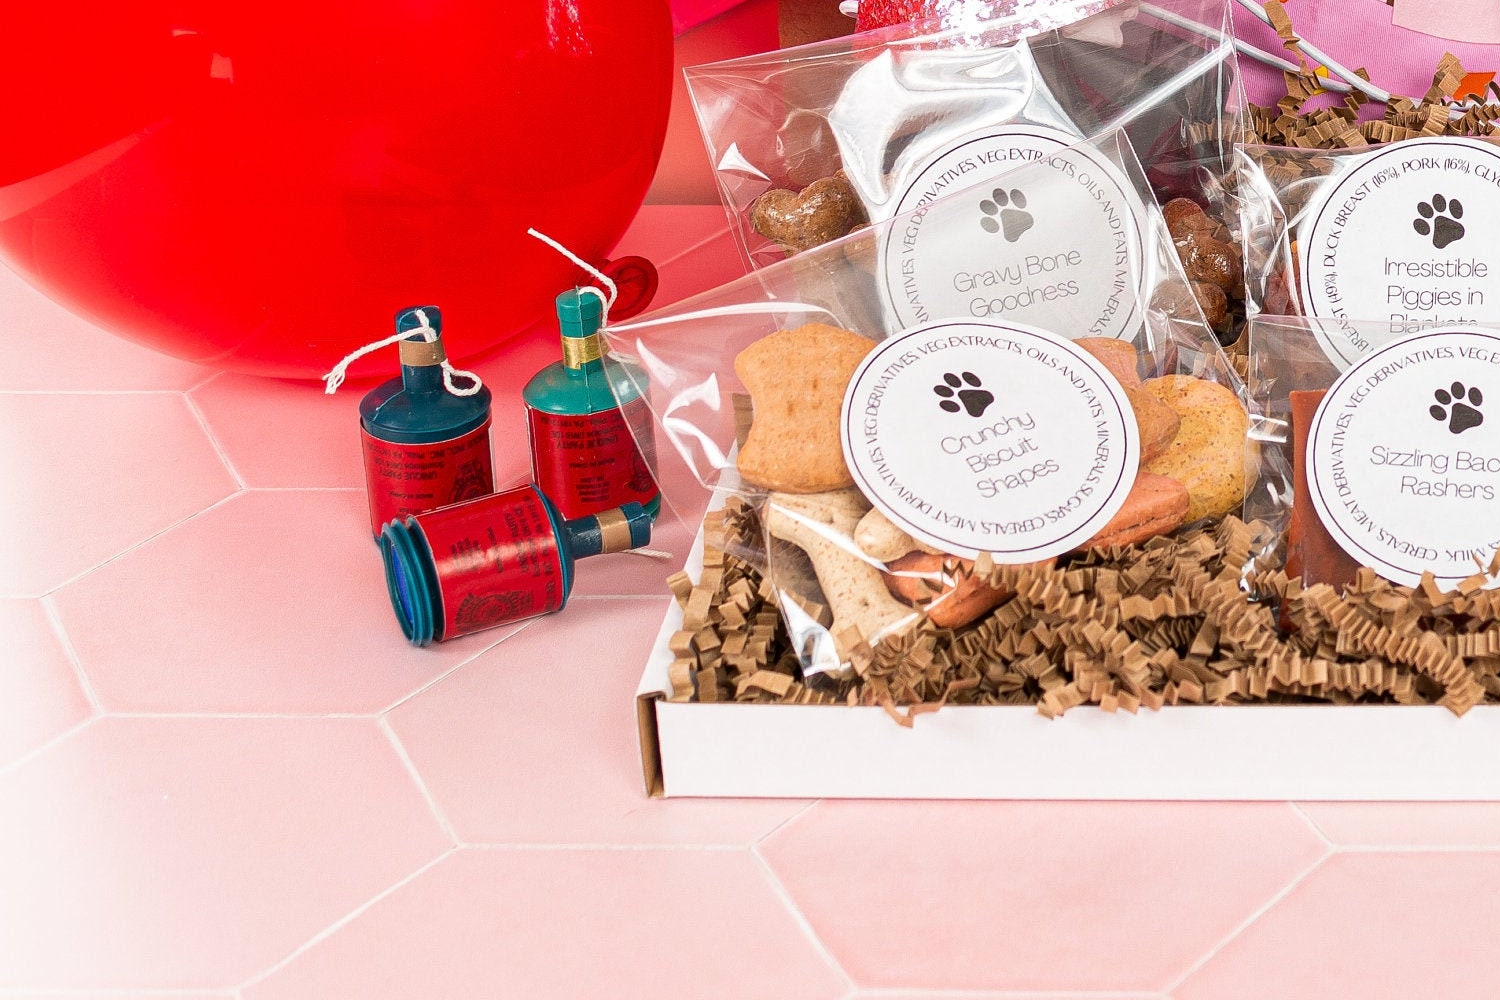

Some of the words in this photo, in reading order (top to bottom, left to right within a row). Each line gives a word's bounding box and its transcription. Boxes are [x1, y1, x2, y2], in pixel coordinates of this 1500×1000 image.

[1401, 157, 1441, 174] PORK
[901, 225, 921, 254] VEG
[976, 148, 1007, 165] VEG
[1077, 173, 1106, 200] OILS
[1102, 201, 1122, 230] AND
[1333, 181, 1371, 228] BREAST
[1323, 229, 1342, 268] DUCK
[953, 264, 1022, 294] Gravy
[1025, 249, 1083, 276] Bone
[1383, 256, 1489, 279] Irresistible
[968, 279, 1080, 319] Goodness
[1386, 284, 1463, 312] Piggies
[1466, 284, 1485, 306] in
[1330, 307, 1370, 353] BREAST
[916, 338, 948, 355] VEG
[1026, 347, 1060, 369] OILS
[1458, 346, 1489, 361] VEG
[1056, 365, 1087, 389] AND
[1344, 384, 1371, 409] VEG
[863, 417, 878, 445] VEG
[940, 410, 1037, 456] Crunchy
[965, 437, 1039, 475] Biscuit
[1369, 444, 1450, 474] Sizzling
[976, 459, 1061, 499] Shapes
[1400, 476, 1495, 501] Rashers
[931, 509, 977, 533] MEAT
[1342, 499, 1377, 533] MEAT
[1445, 548, 1486, 562] MILK
